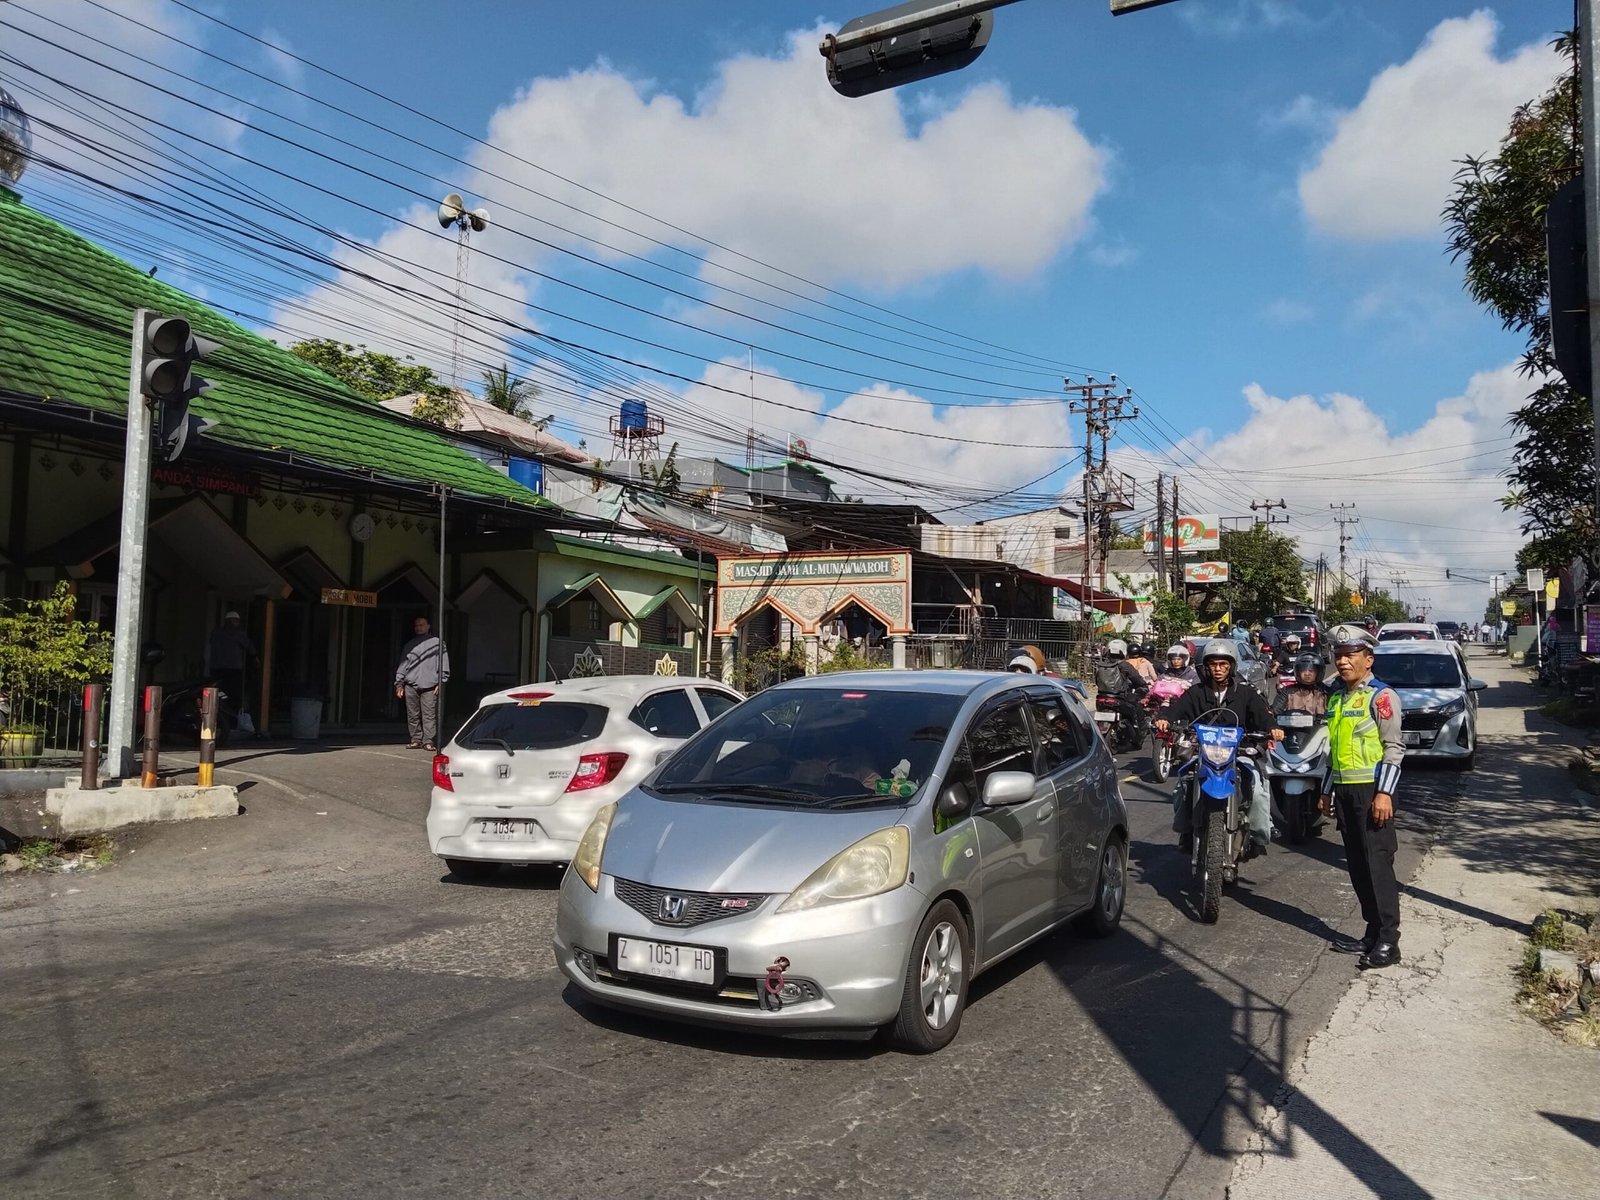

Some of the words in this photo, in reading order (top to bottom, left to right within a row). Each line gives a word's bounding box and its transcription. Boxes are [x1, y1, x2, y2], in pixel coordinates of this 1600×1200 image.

[735, 565, 773, 577] MASJID
[481, 822, 487, 834] Z
[493, 821, 515, 834] 1034
[620, 939, 628, 959] Z
[648, 943, 680, 967] 1051
[694, 950, 712, 971] HD
